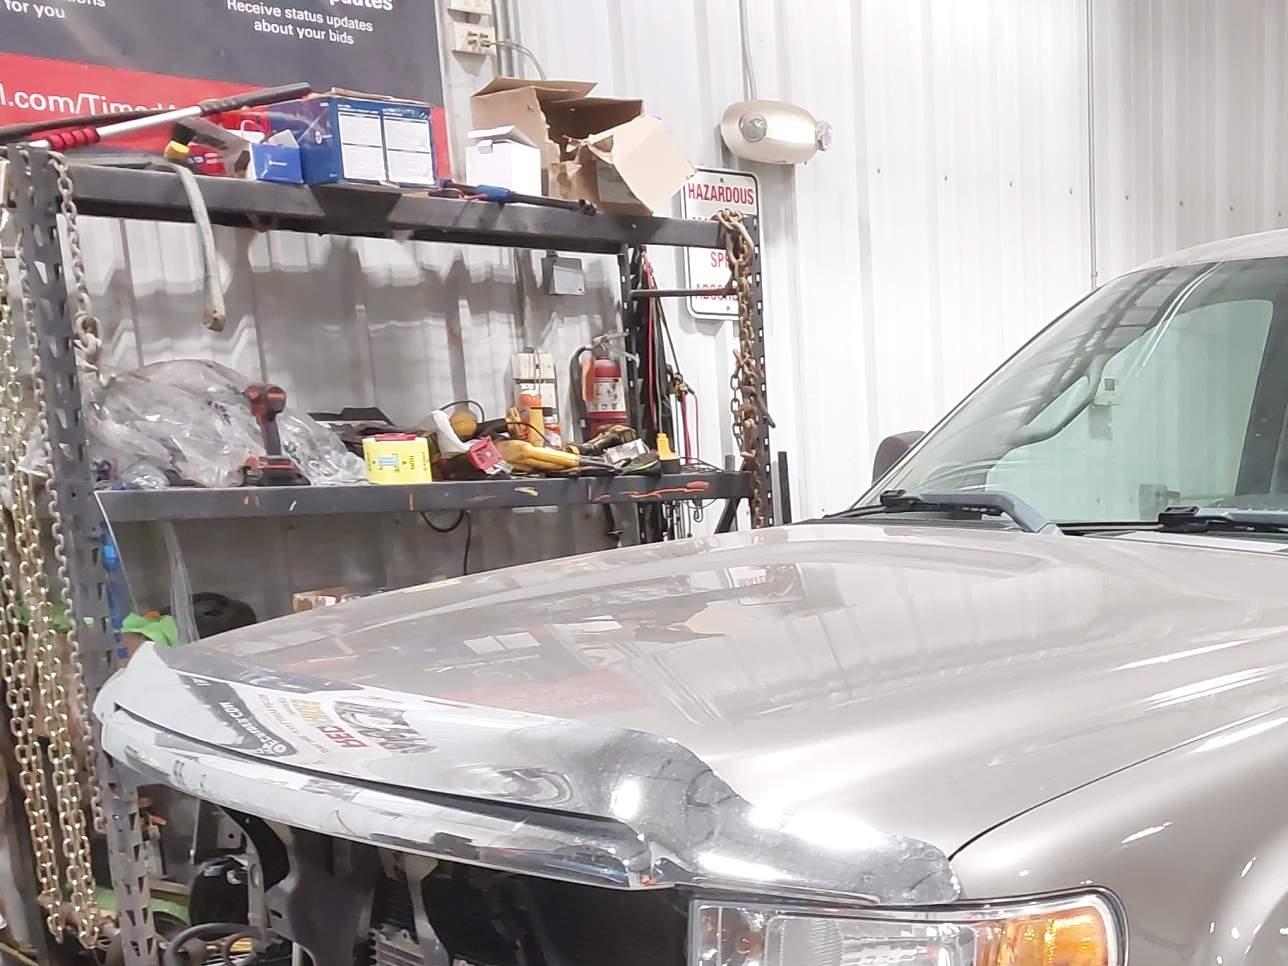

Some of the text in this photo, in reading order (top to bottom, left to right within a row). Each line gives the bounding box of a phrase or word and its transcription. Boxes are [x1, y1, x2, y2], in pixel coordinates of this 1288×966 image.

[4, 0, 65, 18] for you
[226, 0, 374, 32] Receive status updates
[254, 19, 354, 45] about your bids
[687, 183, 754, 205] HAZARDOUS
